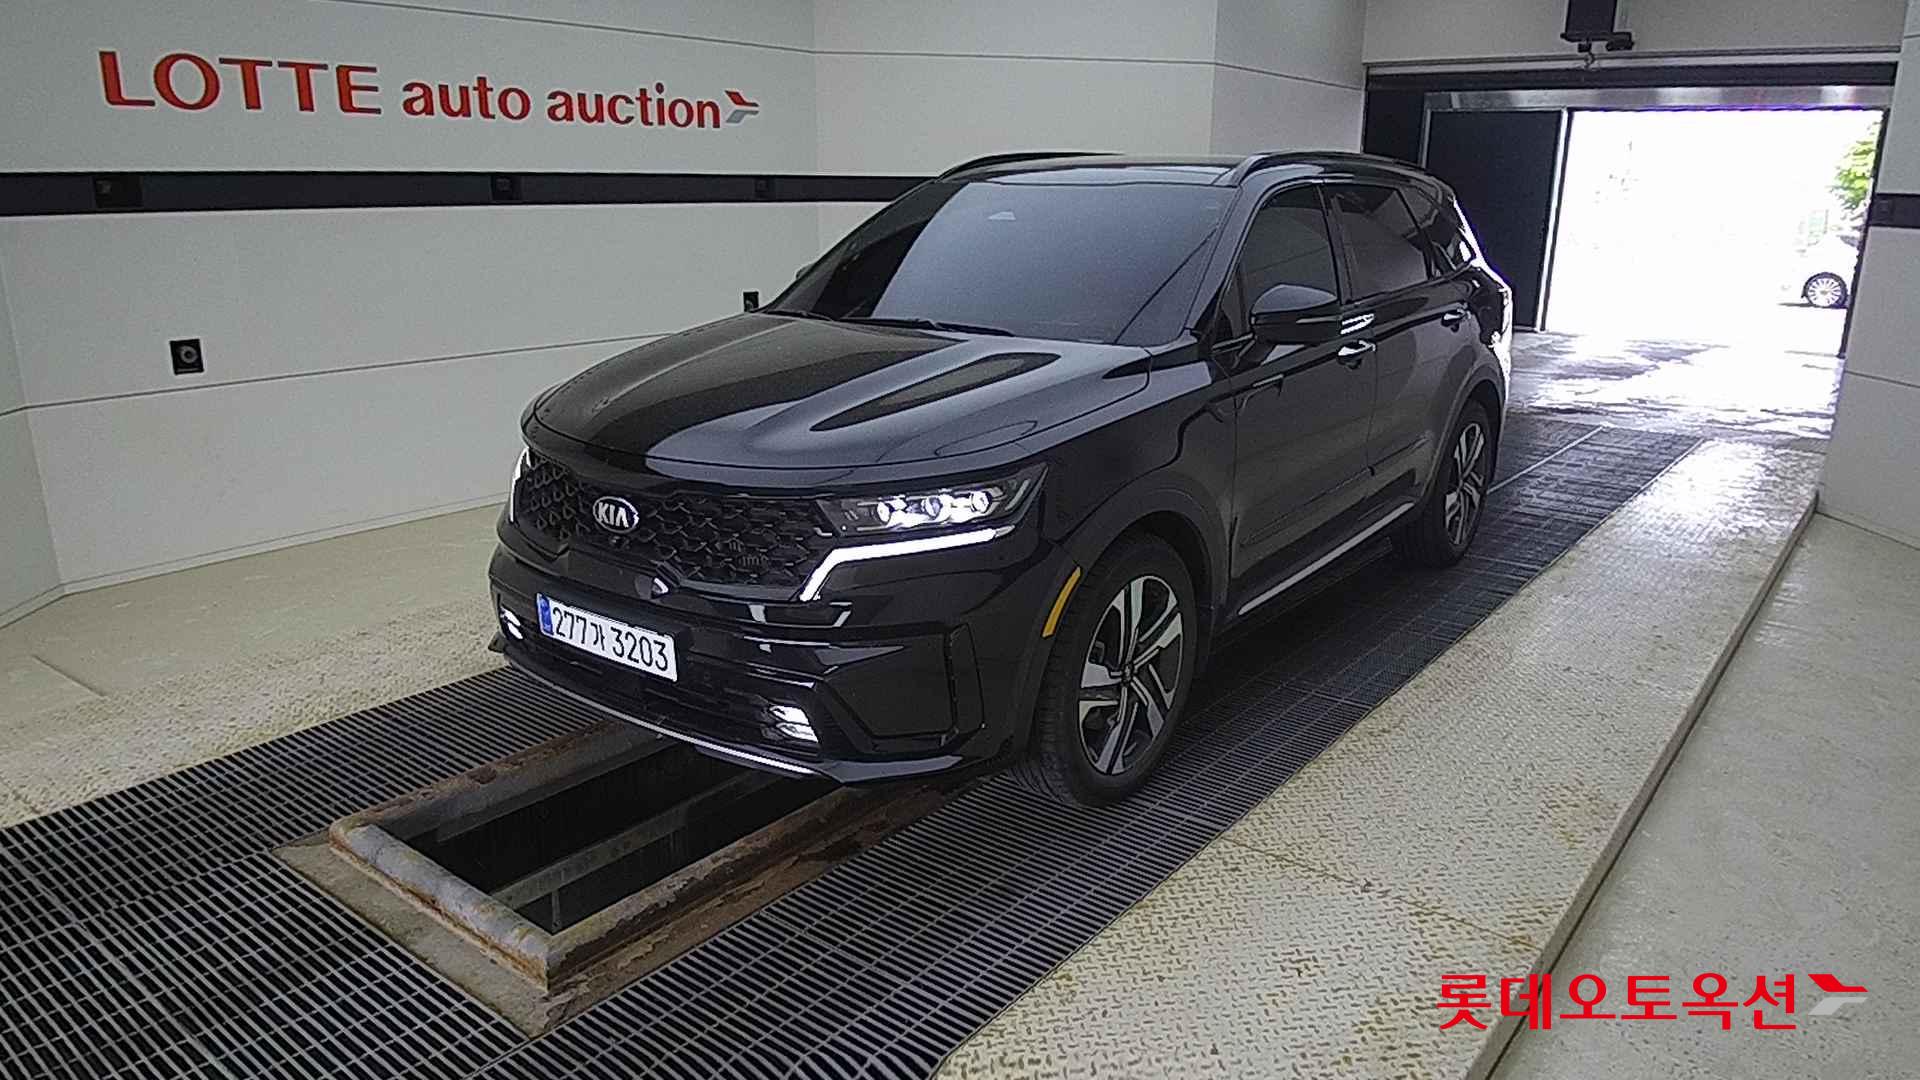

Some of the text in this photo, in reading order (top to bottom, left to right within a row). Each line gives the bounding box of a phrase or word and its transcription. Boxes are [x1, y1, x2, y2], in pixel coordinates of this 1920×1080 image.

[98, 50, 721, 129] LOTTE auto auction
[598, 502, 629, 528] KIA
[552, 606, 669, 671] 277가 3203
